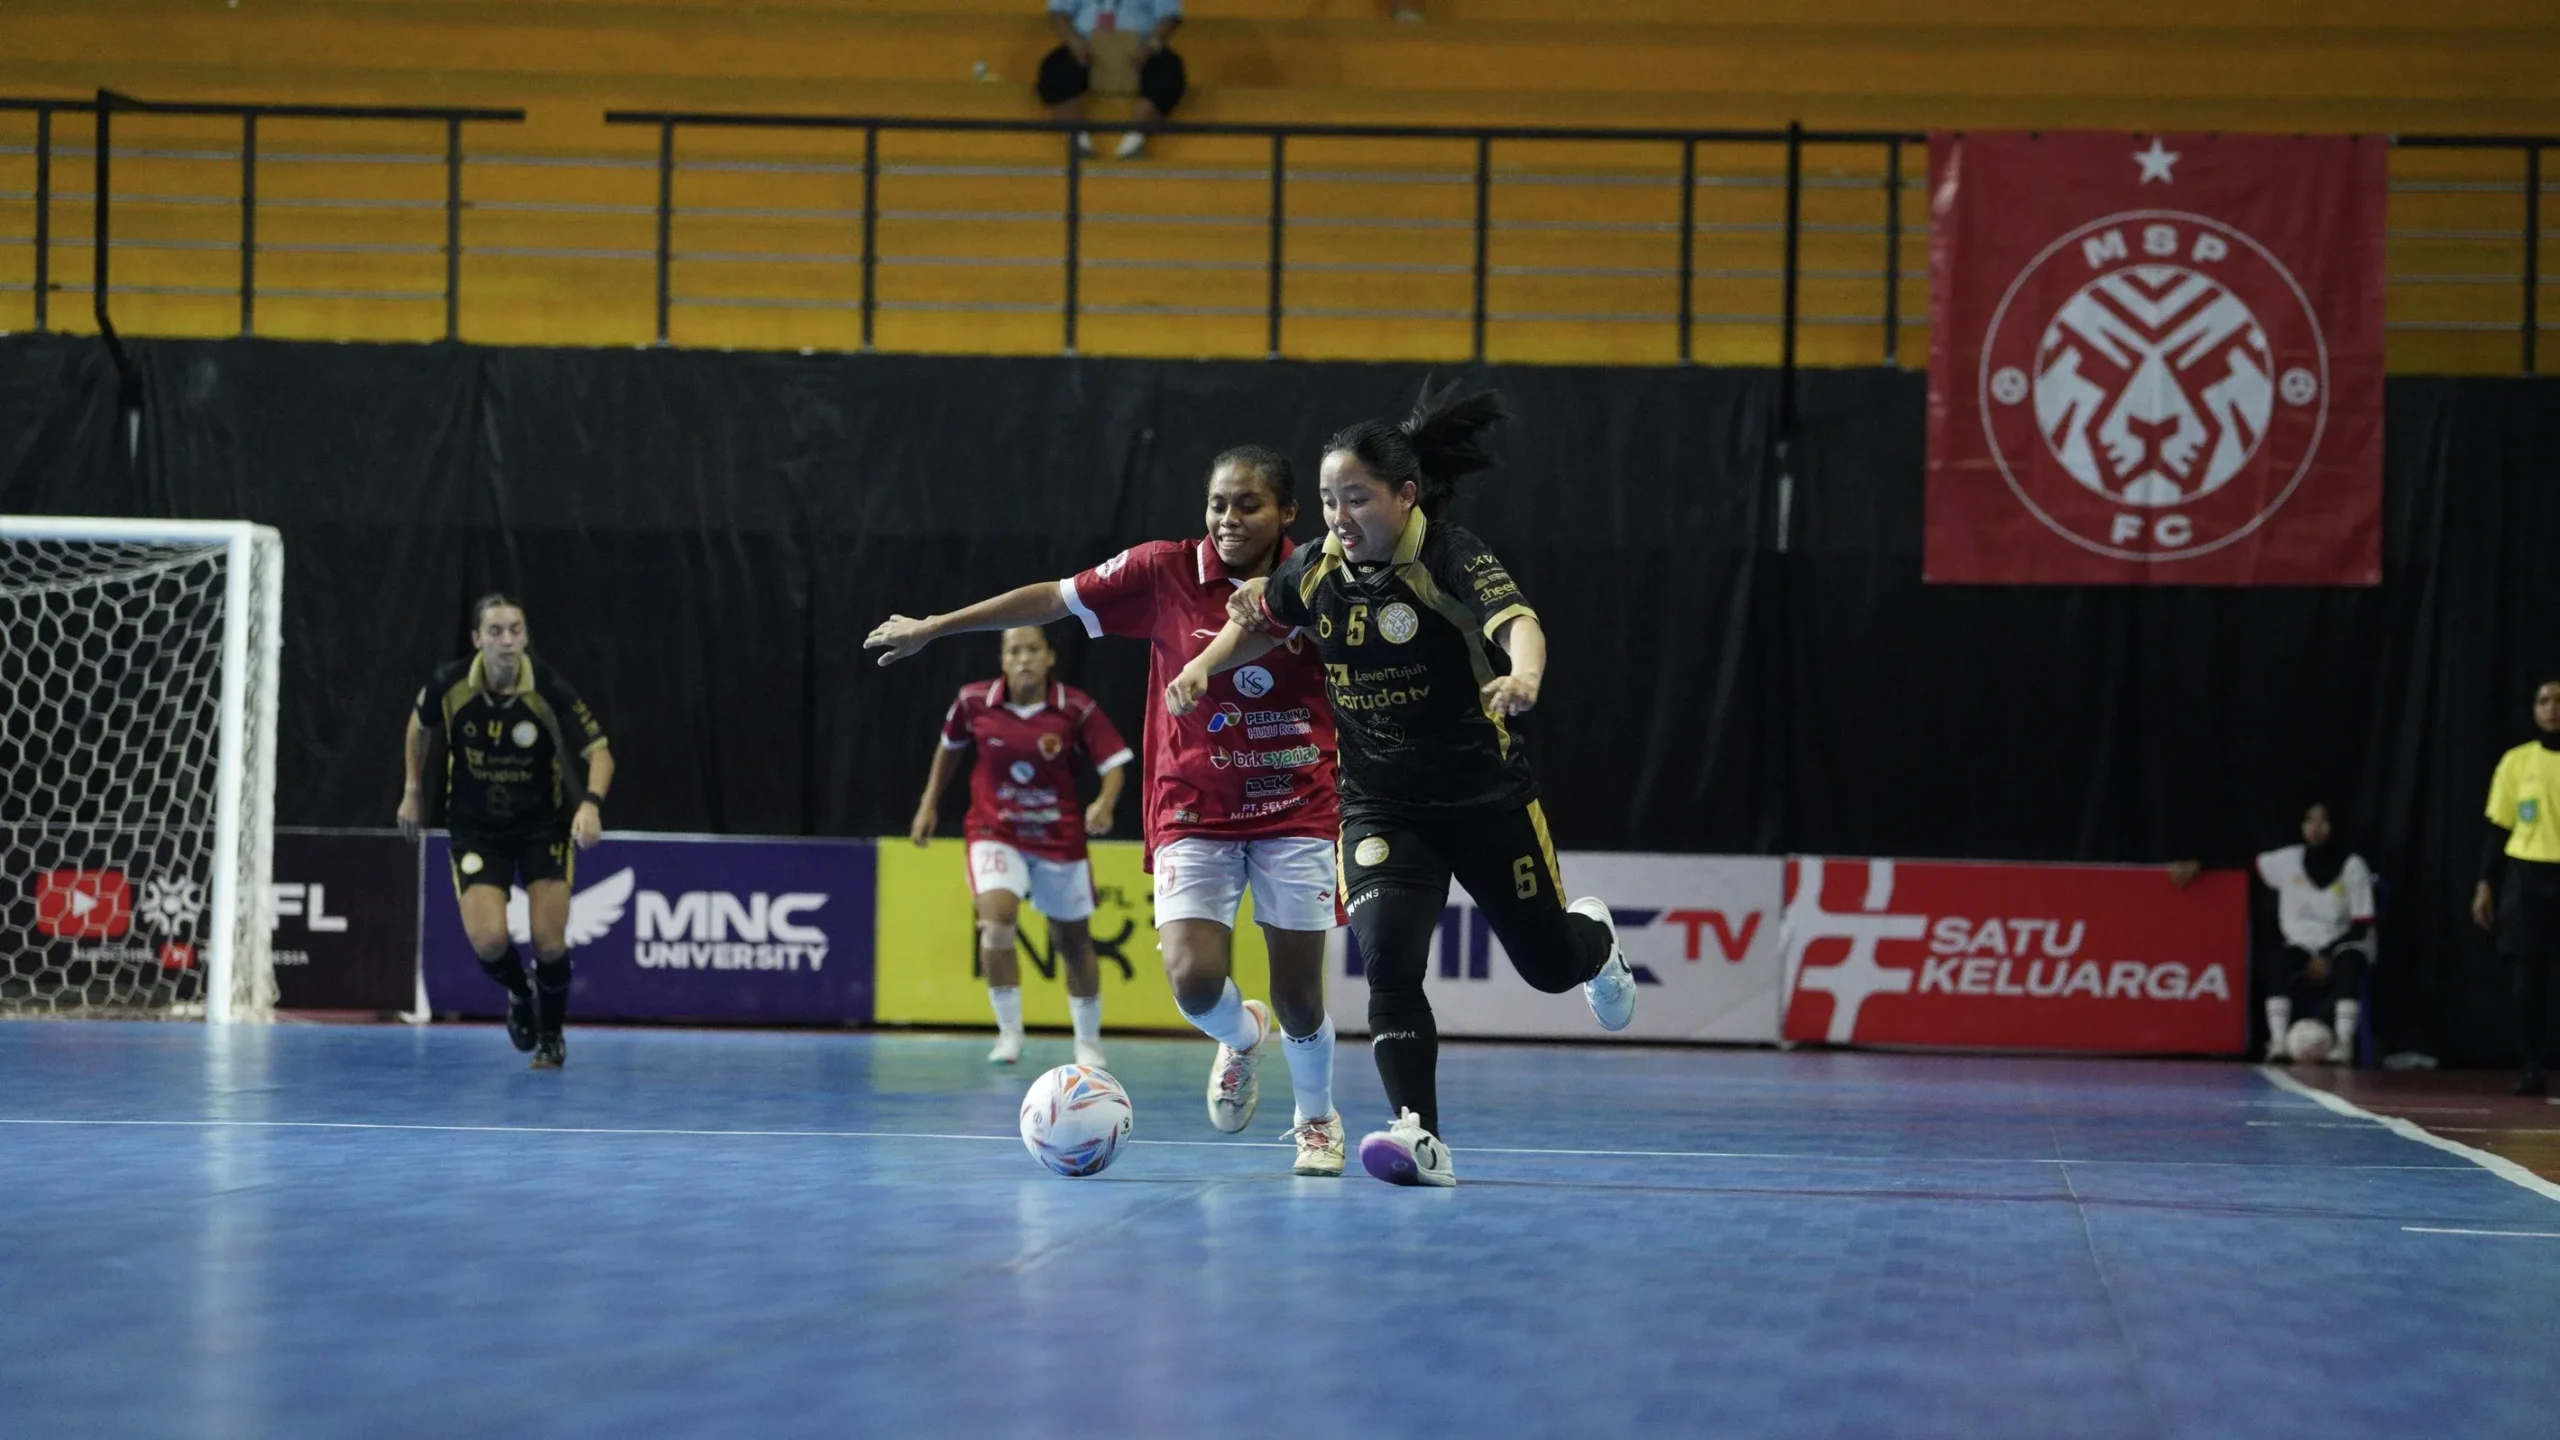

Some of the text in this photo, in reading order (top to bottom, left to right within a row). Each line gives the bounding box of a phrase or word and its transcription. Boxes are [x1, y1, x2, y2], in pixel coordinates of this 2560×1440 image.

[2082, 224, 2229, 269] MSP
[2110, 514, 2192, 547] FC
[1346, 604, 1368, 646] 6
[1241, 670, 1265, 695] KS
[1354, 663, 1427, 682] LevelTujuh
[1409, 685, 1430, 701] tv
[487, 720, 503, 746] 4
[980, 849, 1008, 874] 26
[1513, 855, 1537, 899] 6
[635, 891, 830, 943] MNC
[1664, 910, 1763, 963] TV
[1929, 917, 2085, 957] SATU
[635, 942, 829, 971] UNIVERSITY
[1918, 959, 2231, 1001] KELUARGA
